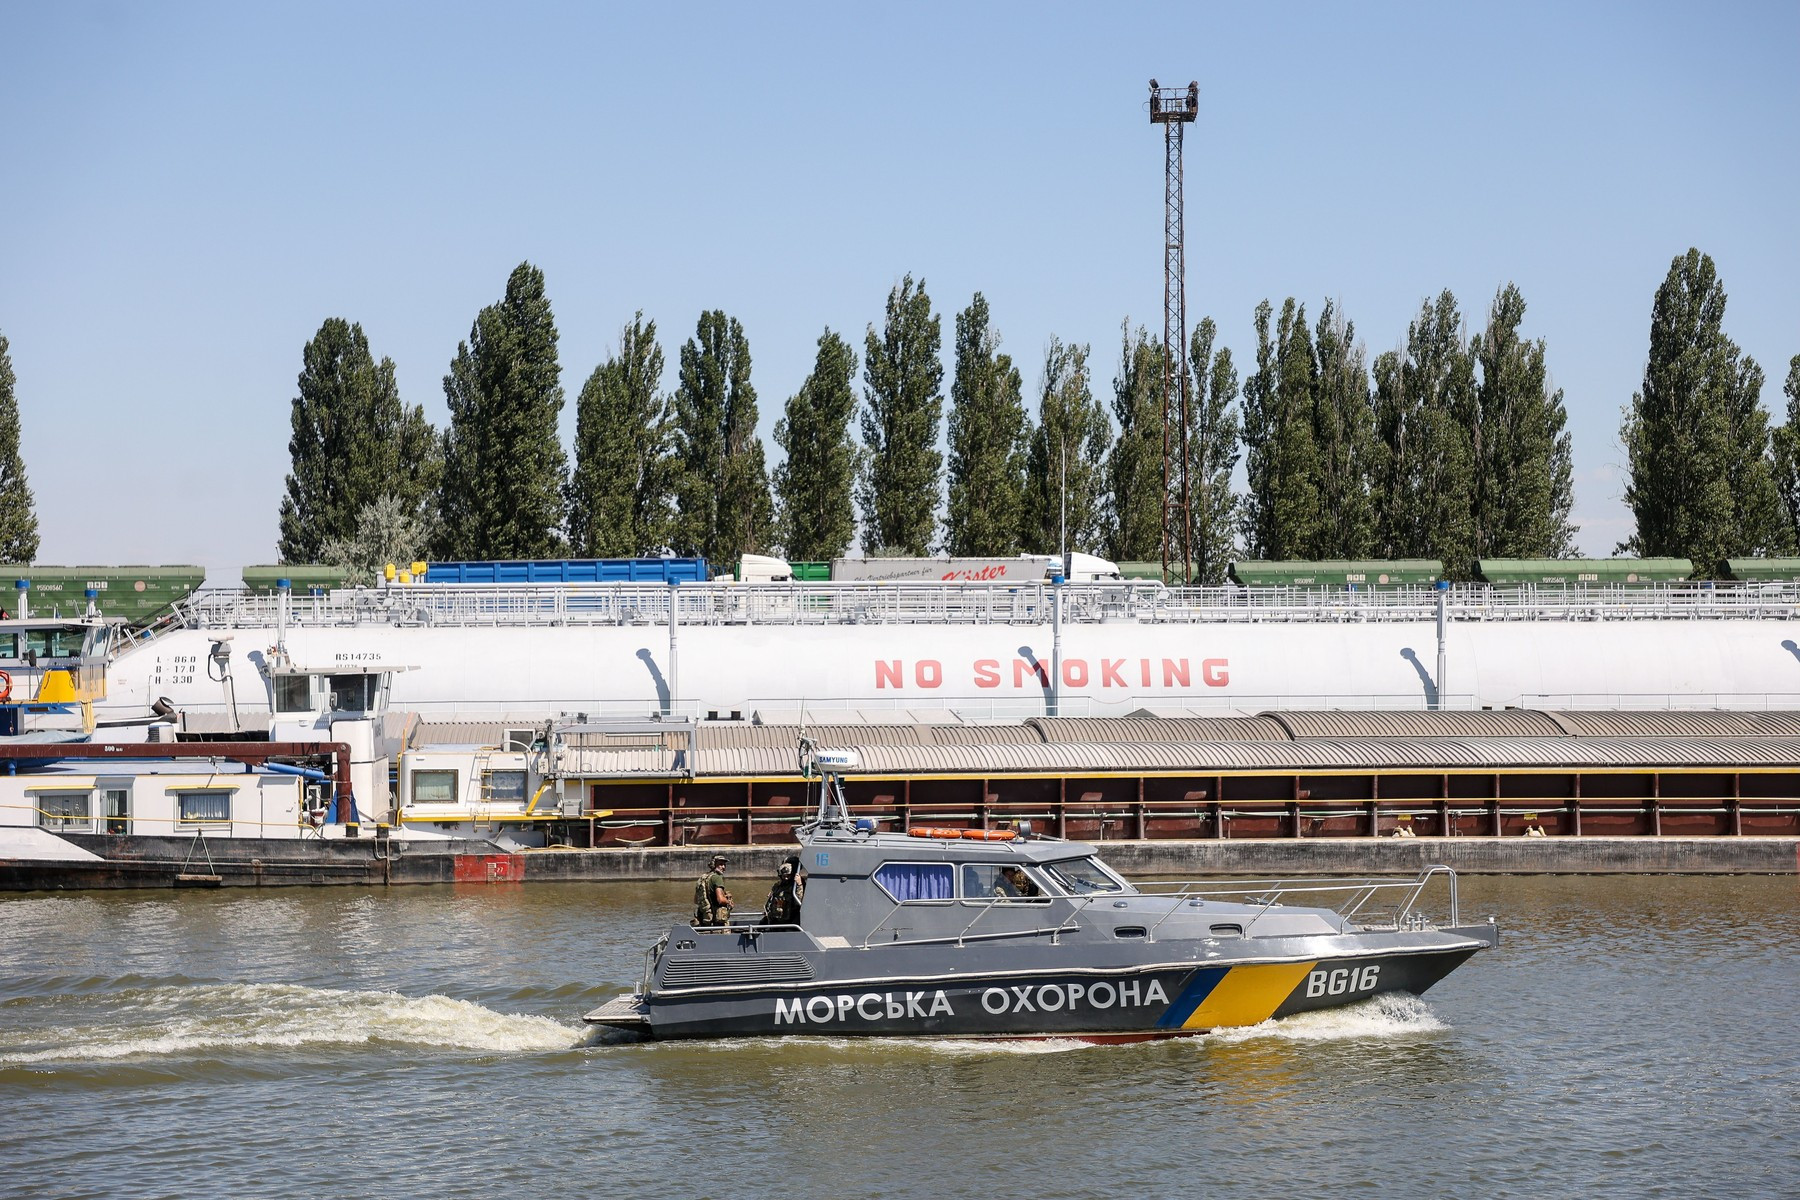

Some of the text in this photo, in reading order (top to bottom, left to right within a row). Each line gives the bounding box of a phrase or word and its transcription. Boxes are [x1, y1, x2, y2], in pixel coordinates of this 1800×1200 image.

[155, 676, 161, 684] H
[875, 659, 1230, 688] NO SMOKING
[819, 756, 848, 764] SAMYUNG
[816, 853, 829, 867] 16
[1306, 965, 1380, 998] BG16
[774, 979, 1170, 1025] МОРСЬКА ОХОРОНА
